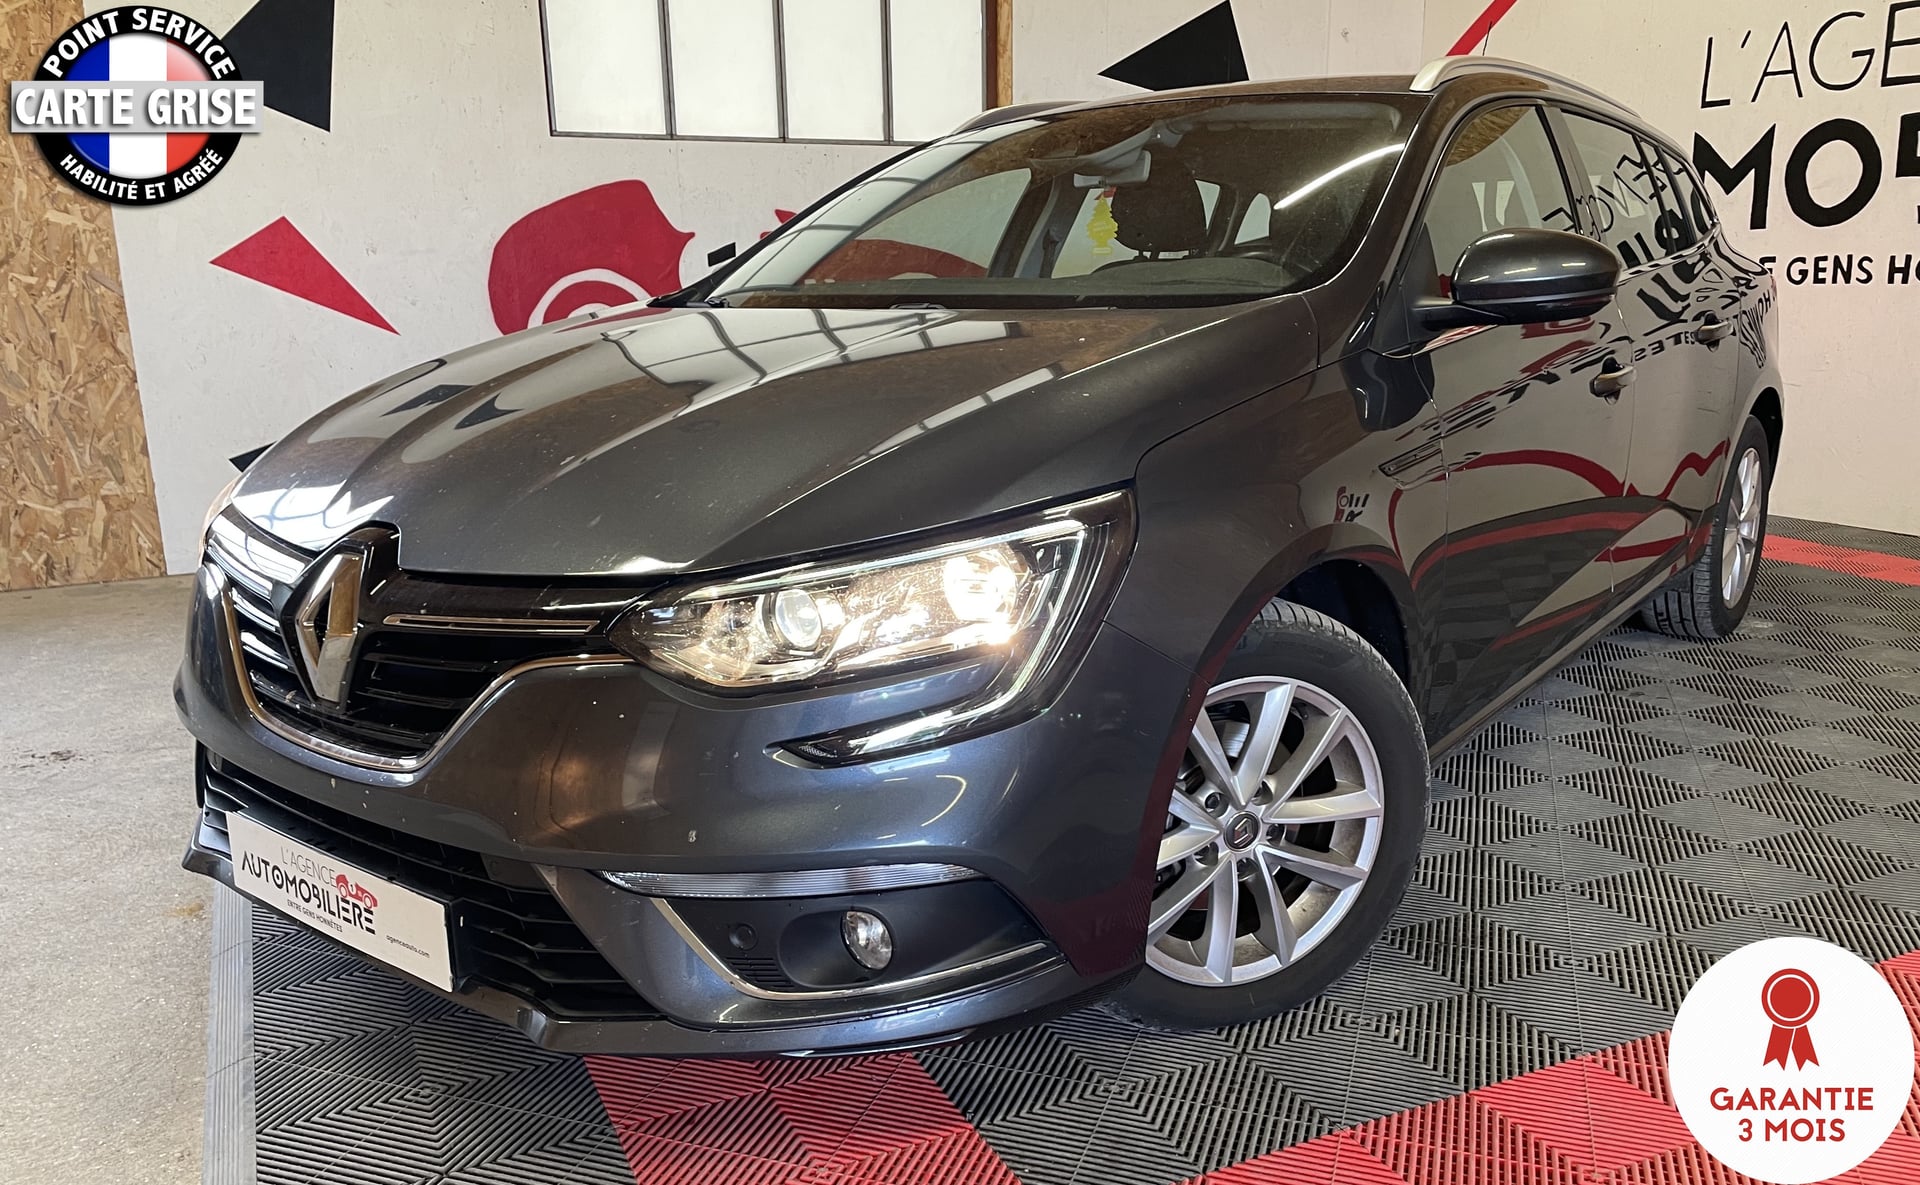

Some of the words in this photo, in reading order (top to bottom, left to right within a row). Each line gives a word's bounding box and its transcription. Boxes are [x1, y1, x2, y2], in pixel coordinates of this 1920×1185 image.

[1786, 254, 1874, 285] GENS
[1887, 254, 1920, 284] H
[281, 846, 338, 889] L'AGENCE
[287, 899, 302, 912] ENTRE
[302, 907, 316, 919] GENS
